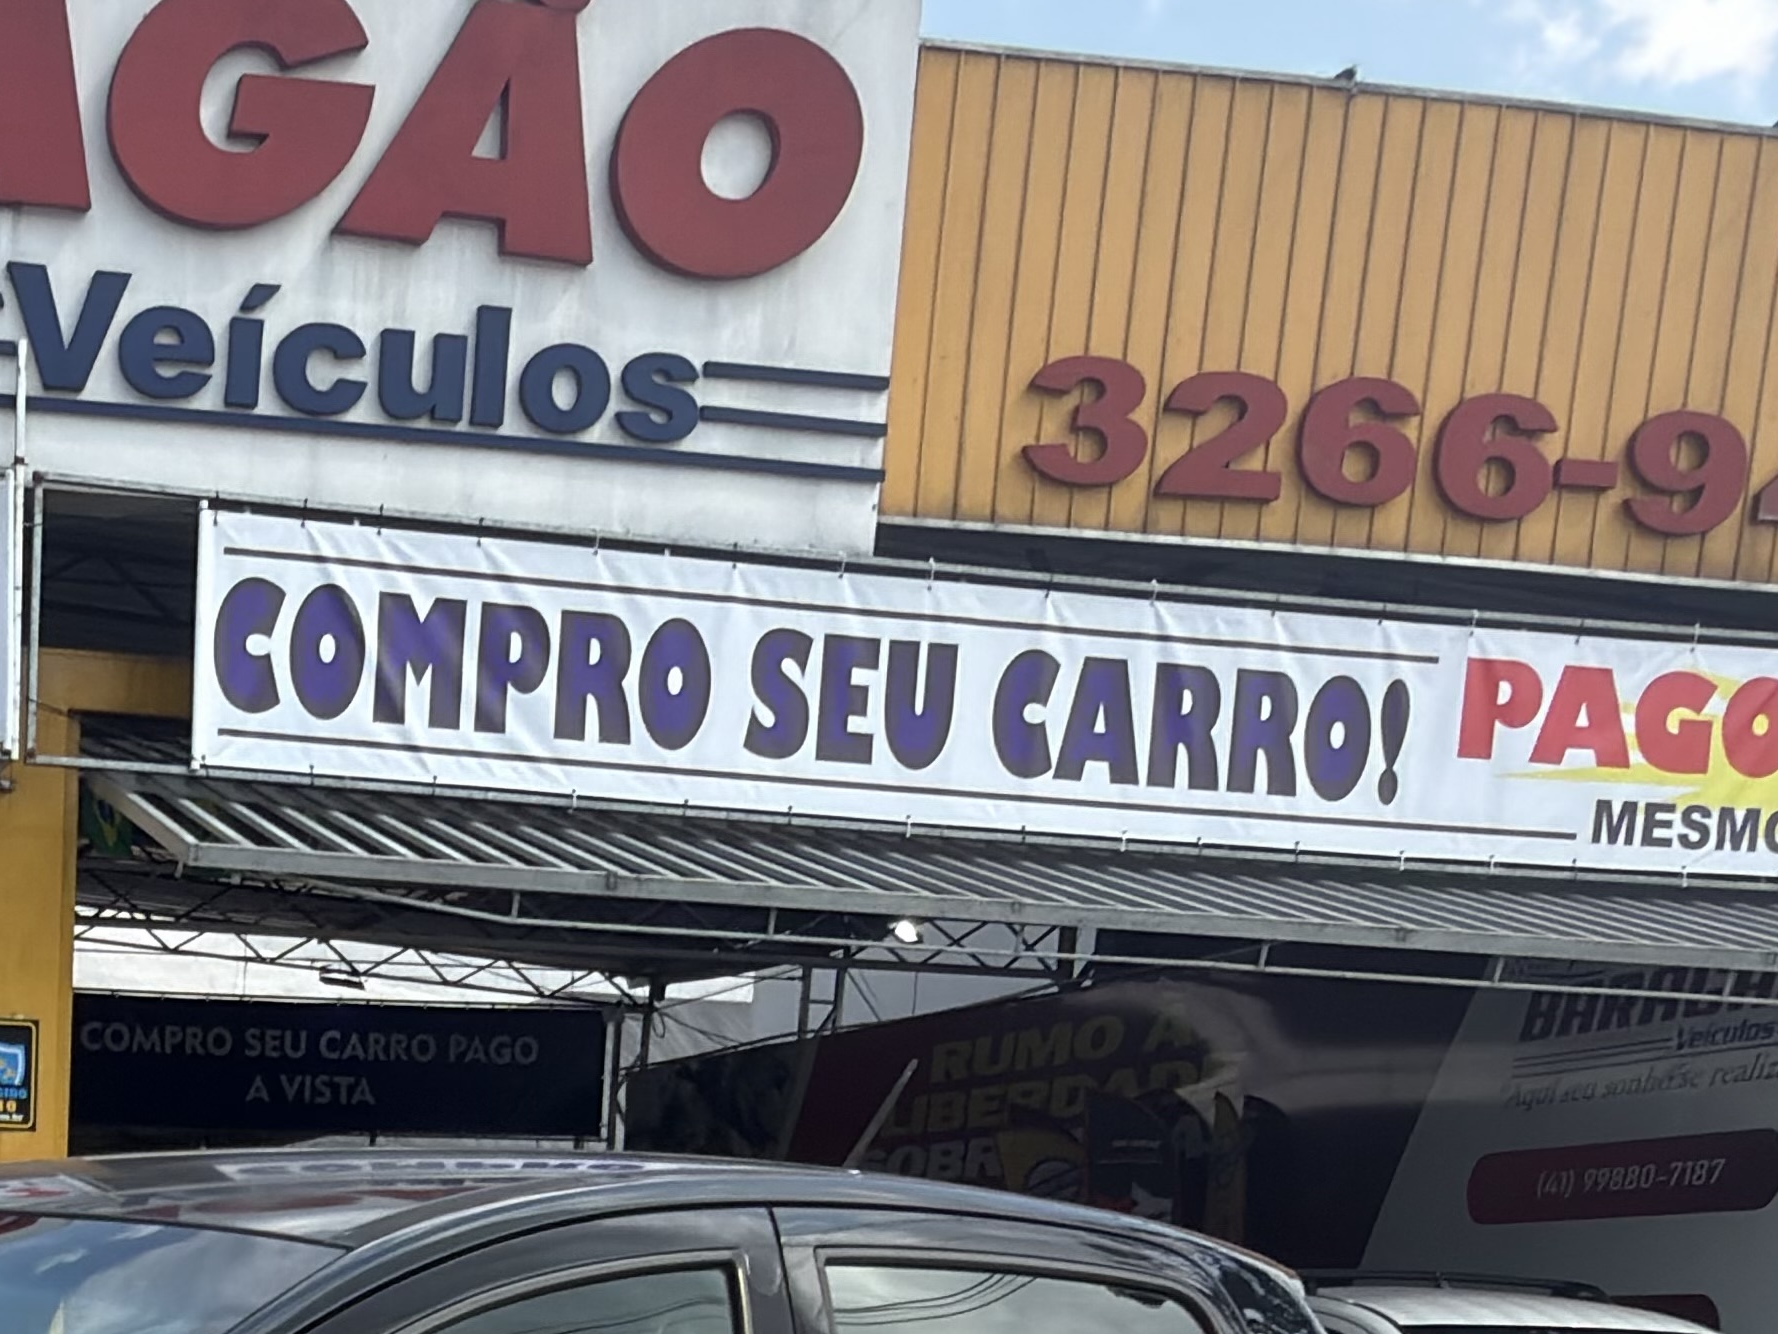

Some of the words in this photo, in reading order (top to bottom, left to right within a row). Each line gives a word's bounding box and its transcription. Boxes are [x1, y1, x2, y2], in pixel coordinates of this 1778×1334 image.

[7, 260, 703, 443] Veículos
[212, 576, 713, 753] COMPRO
[741, 626, 961, 771] SEU
[991, 648, 1412, 806] CARRO!
[79, 1020, 233, 1058] COMPRO
[244, 1026, 307, 1060] SEU
[318, 1029, 437, 1064] CARRO
[448, 1033, 539, 1067] PAGO
[929, 1014, 1125, 1086] RUMO
[245, 1075, 271, 1105] A
[281, 1074, 377, 1106] VISTA
